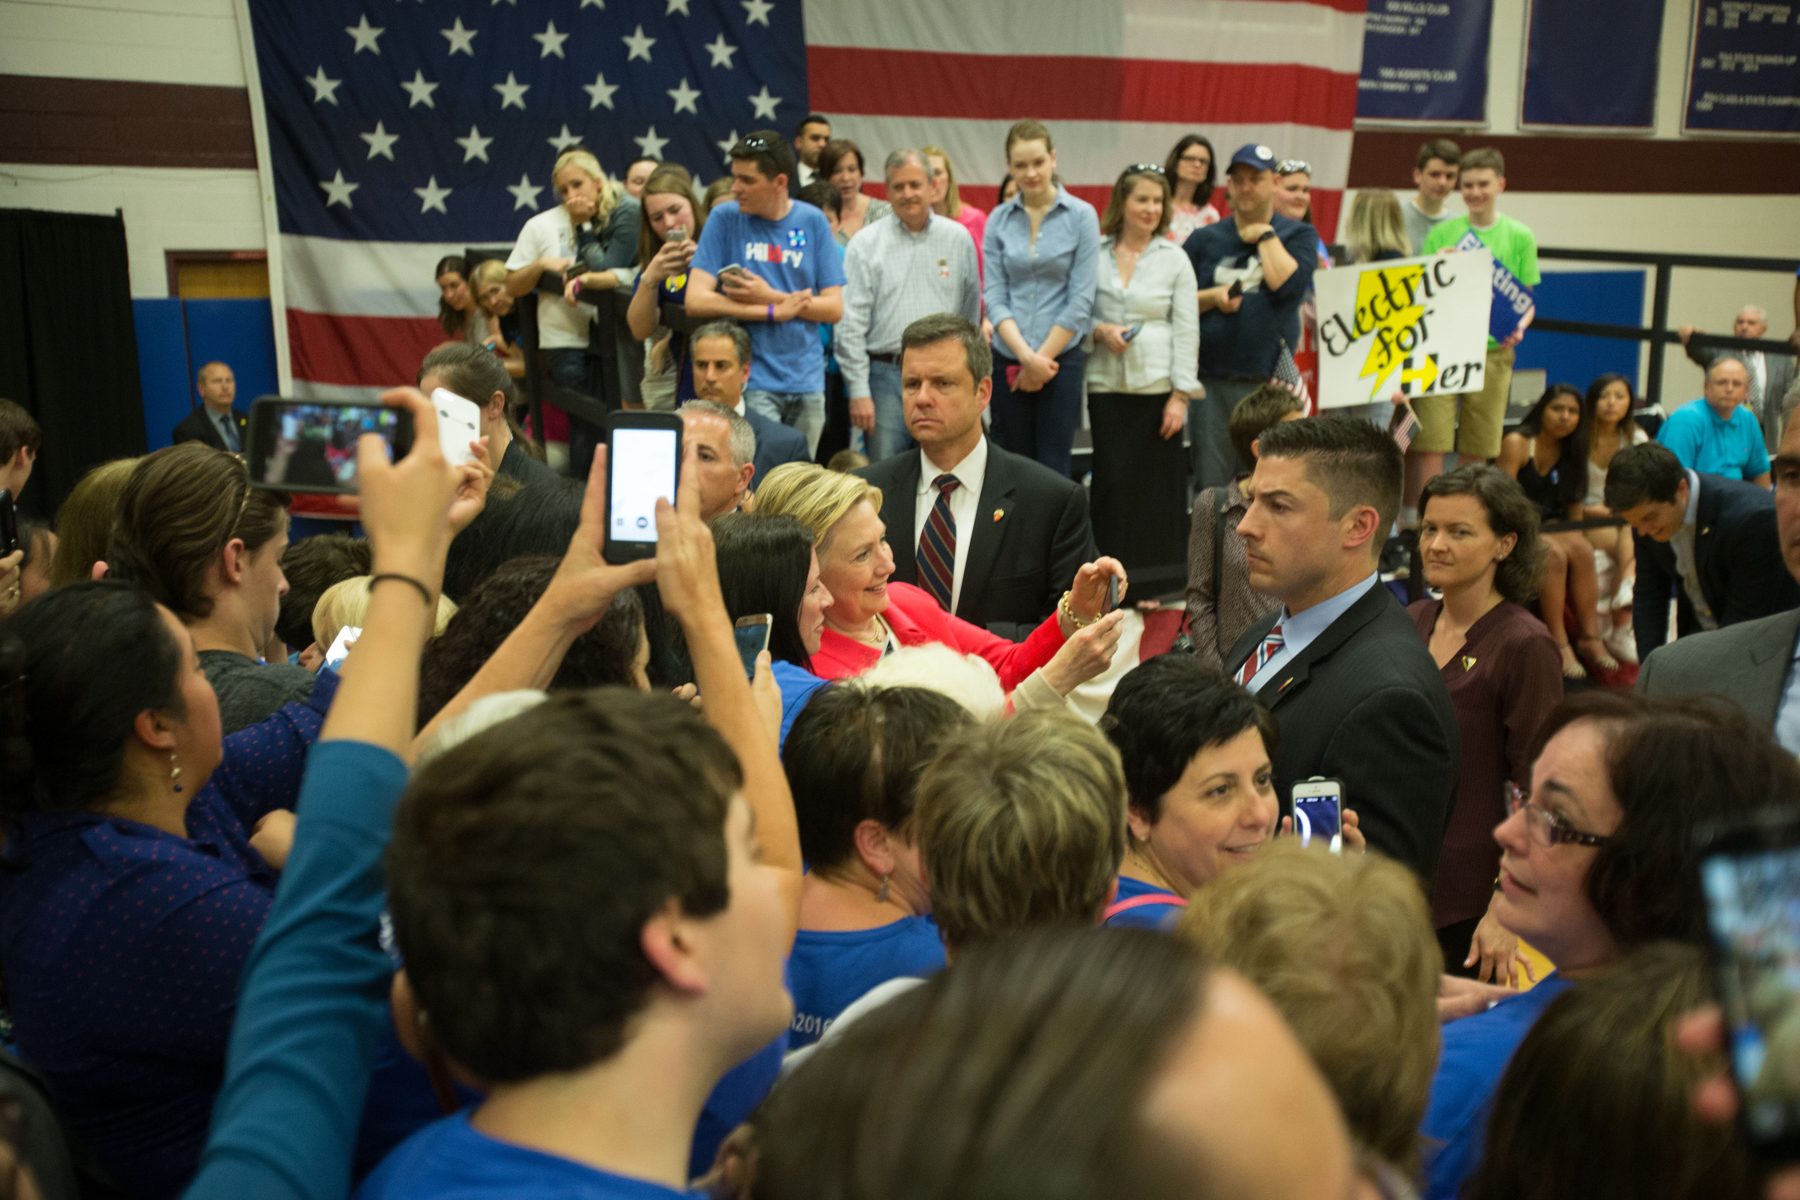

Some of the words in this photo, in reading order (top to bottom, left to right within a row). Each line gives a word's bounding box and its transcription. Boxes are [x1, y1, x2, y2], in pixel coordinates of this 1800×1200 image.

[1320, 259, 1456, 357] Electric
[1377, 308, 1435, 369] for
[1400, 353, 1483, 395] Her
